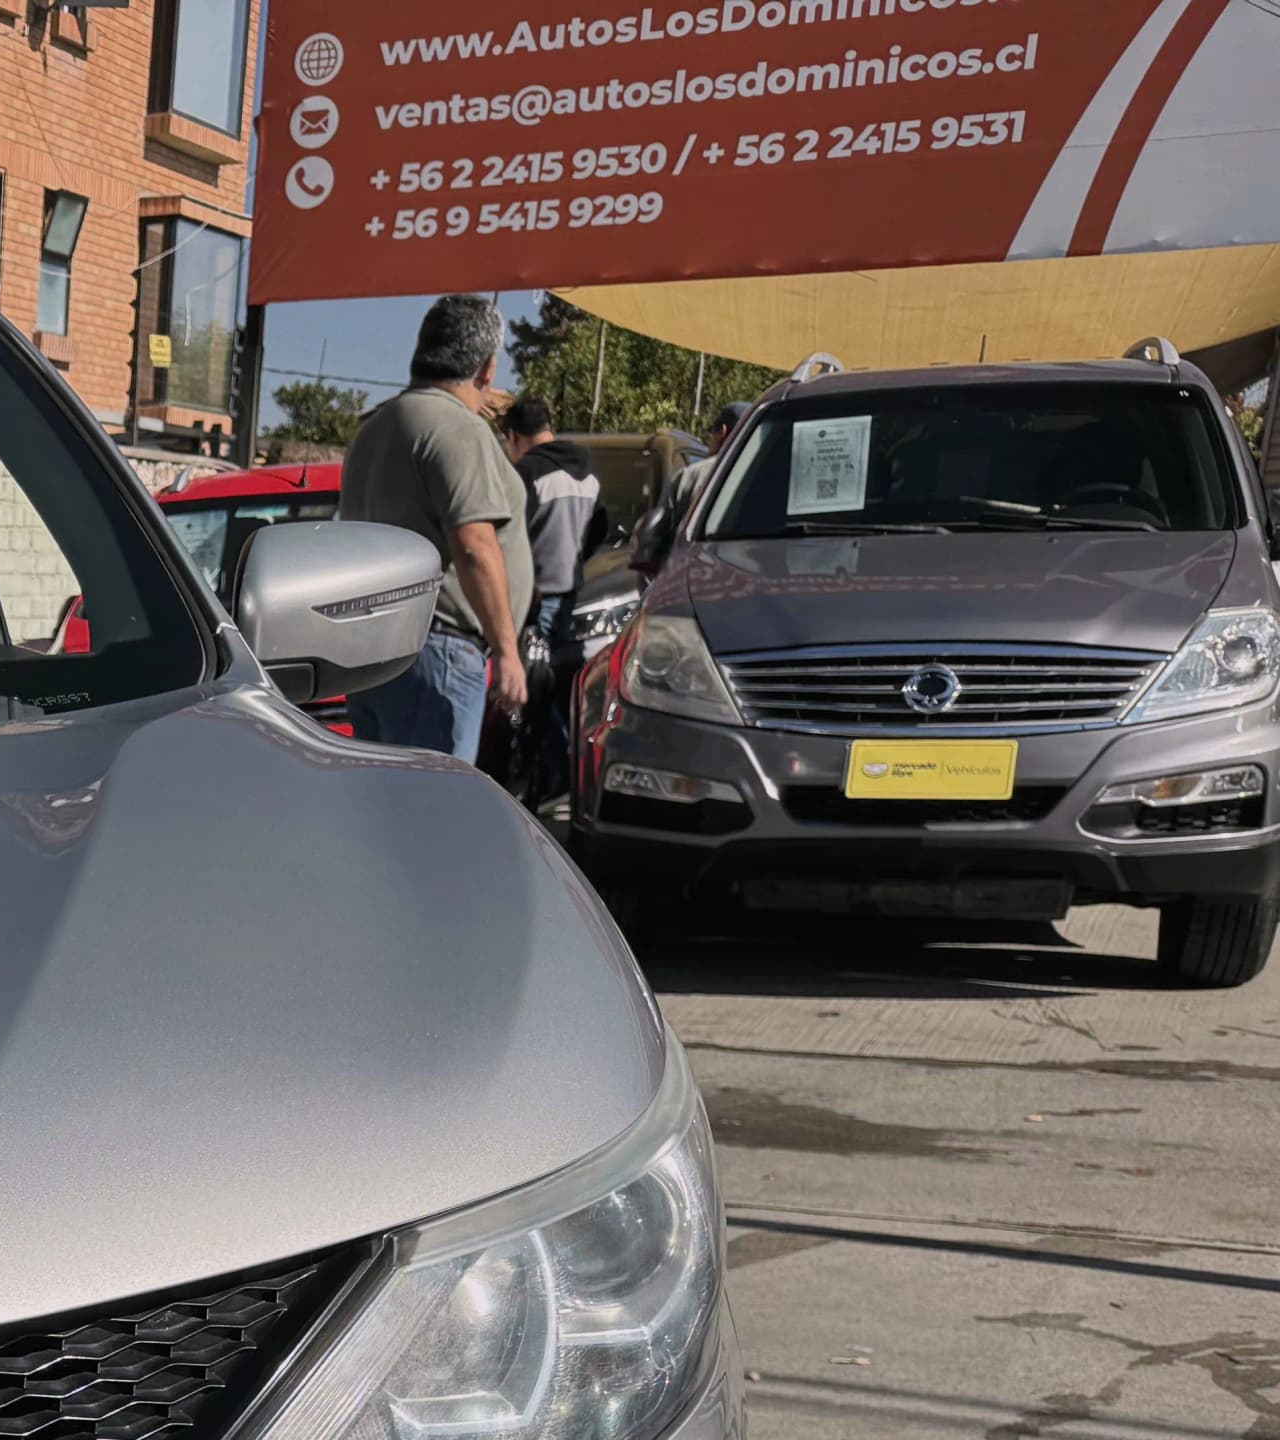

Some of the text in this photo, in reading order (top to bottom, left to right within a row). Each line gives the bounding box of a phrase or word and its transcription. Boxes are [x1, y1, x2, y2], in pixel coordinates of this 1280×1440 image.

[375, 33, 1039, 130] ventas@autoslosdominicos.cl
[398, 161, 444, 193] 56
[450, 158, 474, 189] 2
[480, 151, 564, 187] 2415
[572, 142, 667, 181] 9530
[671, 134, 697, 176] /
[734, 132, 786, 167] 56
[793, 129, 819, 162] 2
[827, 120, 921, 158] 2415
[930, 110, 1026, 150] 9531
[392, 208, 438, 240] 56
[445, 206, 470, 237] 9
[476, 199, 561, 235] 5415
[568, 191, 664, 228] 9299
